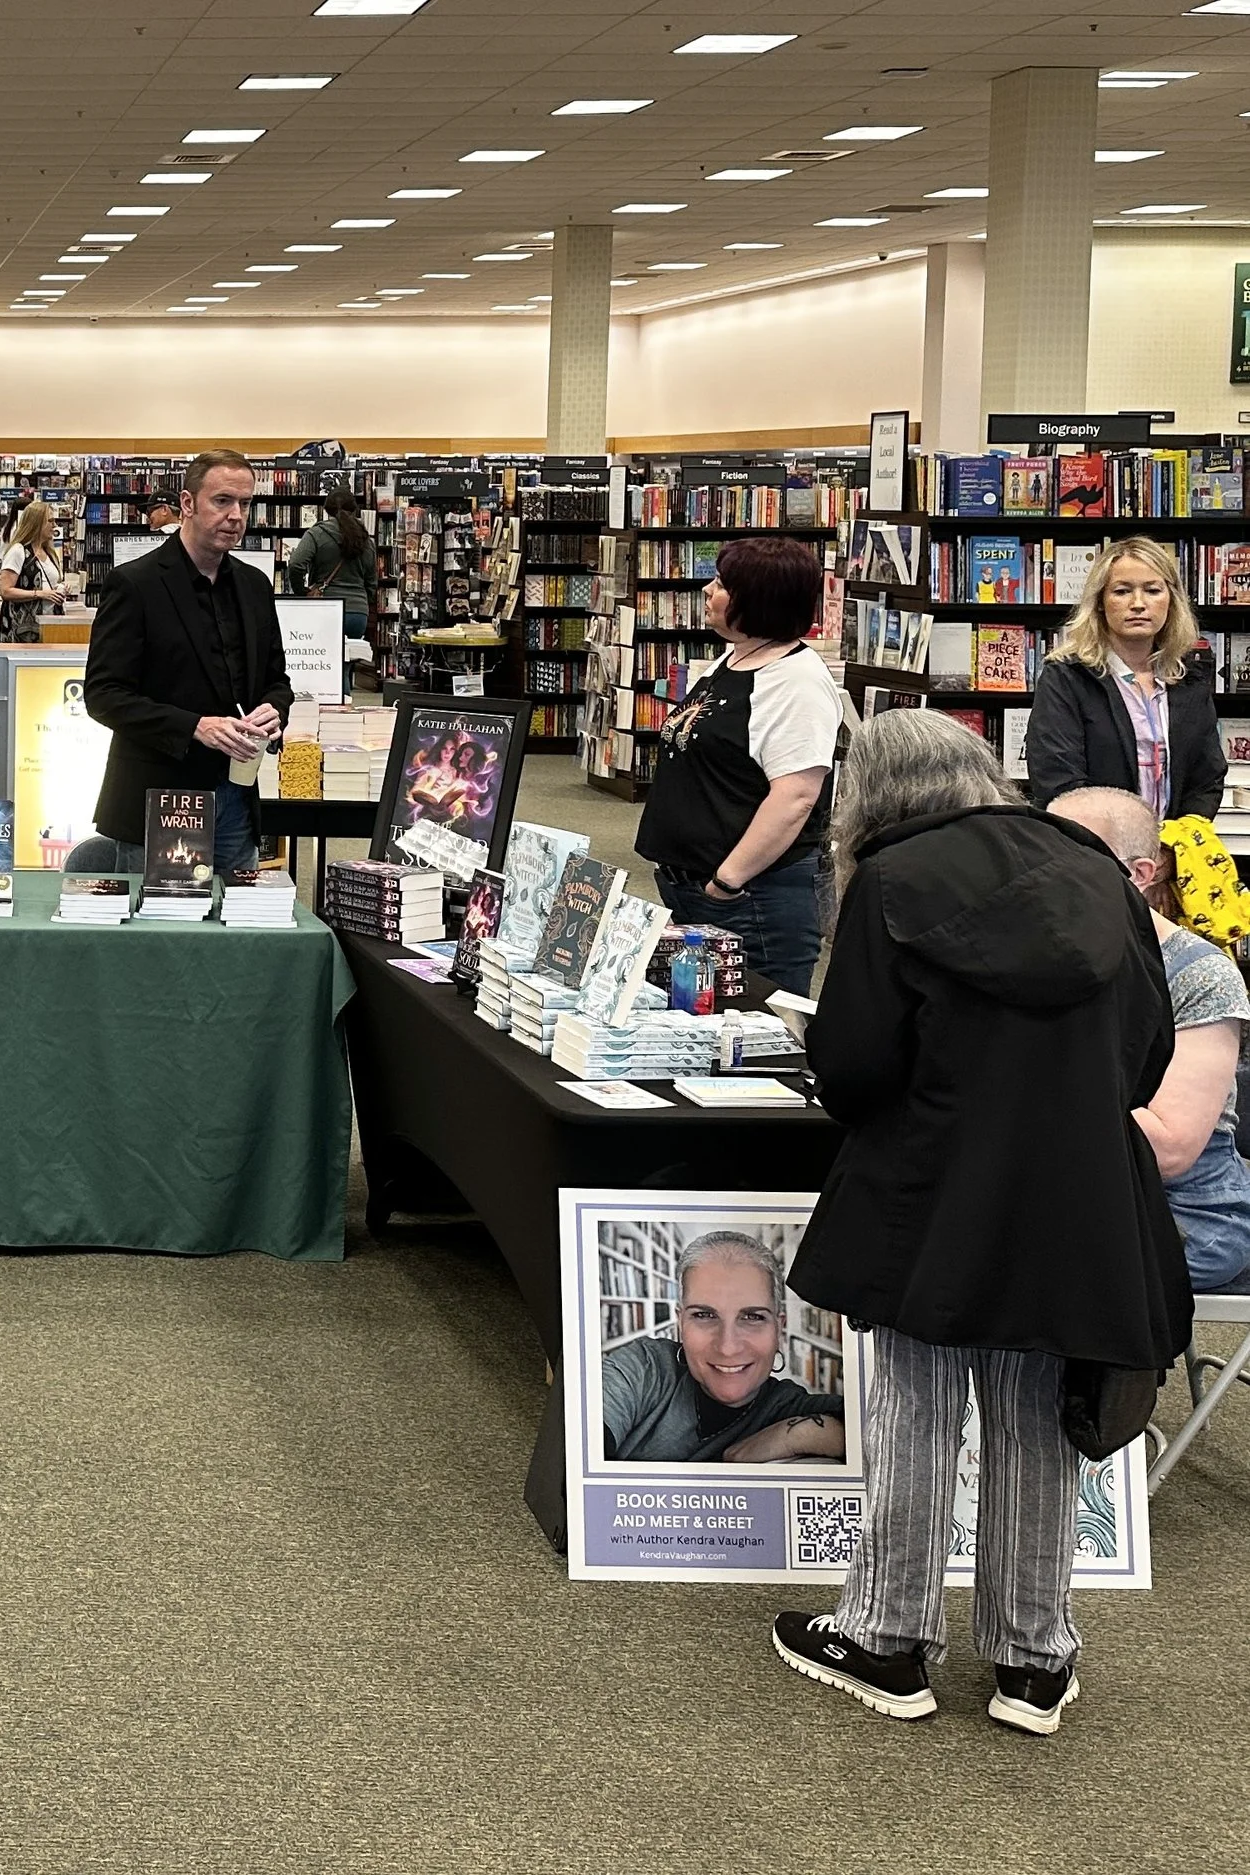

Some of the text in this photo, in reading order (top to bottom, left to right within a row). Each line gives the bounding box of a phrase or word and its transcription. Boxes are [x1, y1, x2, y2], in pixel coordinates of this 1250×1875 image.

[879, 424, 892, 434] Read
[1039, 423, 1100, 437] Biography
[879, 447, 894, 457] Local
[571, 472, 600, 480] Classics
[721, 472, 748, 480] Fiction
[975, 549, 1015, 559] SPENT
[289, 630, 314, 640] New
[1000, 631, 1009, 642] A
[988, 644, 1019, 656] PIECE
[994, 656, 1010, 666] OF
[984, 667, 1018, 680] CAKE
[894, 694, 916, 706] FIRE
[417, 719, 504, 735] KATIE HALLAHAN
[160, 794, 204, 810] FIRE
[160, 816, 204, 829] WRATH
[567, 897, 593, 915] WITCH
[696, 974, 711, 991] FIJ
[616, 1493, 748, 1510] BOOK SIGNING
[613, 1515, 754, 1529] AND MEET & GREET
[610, 1534, 765, 1547] with Author Kendra Vaughan
[640, 1550, 727, 1561] KendraVaughan.com
